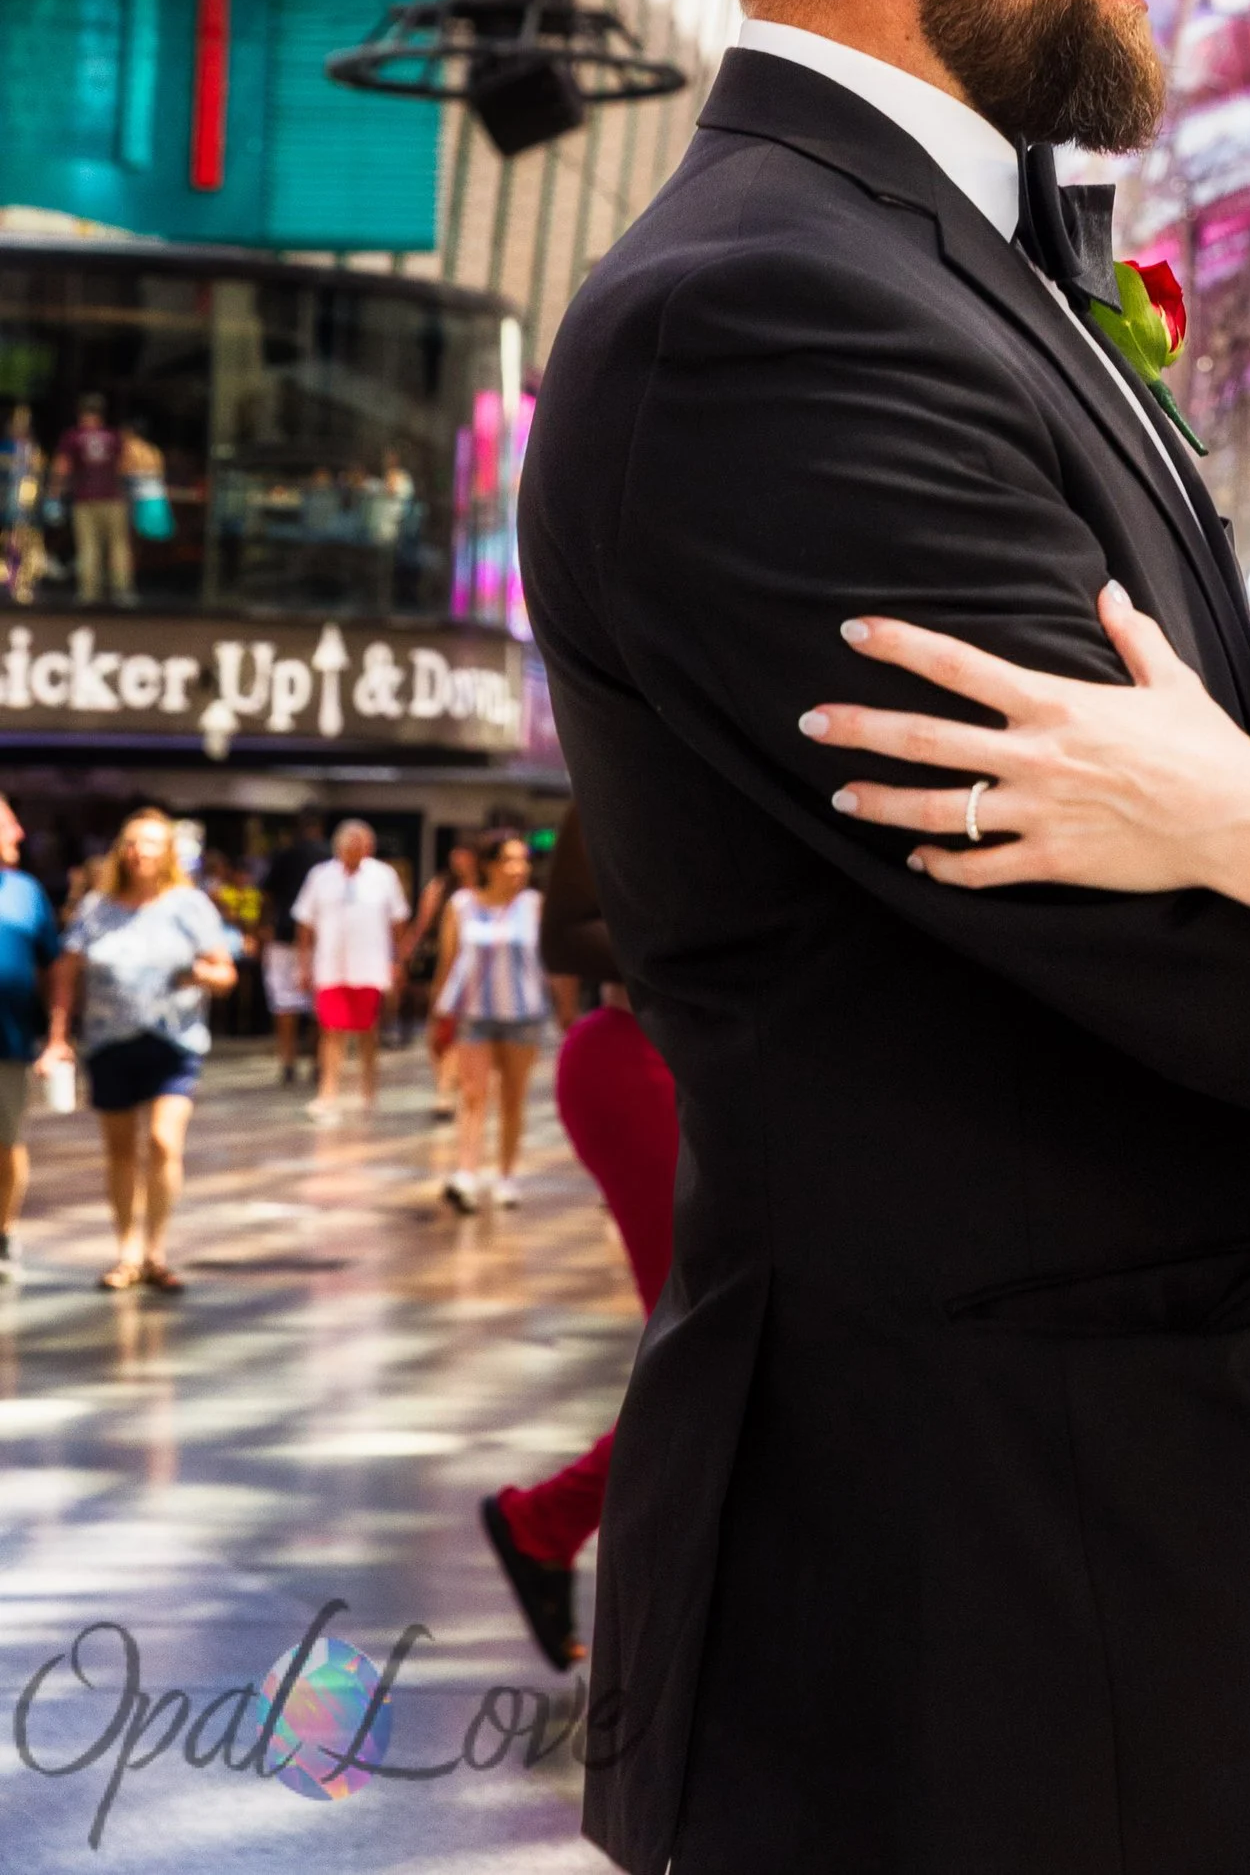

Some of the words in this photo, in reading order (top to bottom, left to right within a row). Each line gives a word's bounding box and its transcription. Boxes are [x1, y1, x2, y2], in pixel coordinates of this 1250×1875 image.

[0, 626, 199, 713] icker
[206, 640, 313, 737] Up
[352, 640, 405, 721] &
